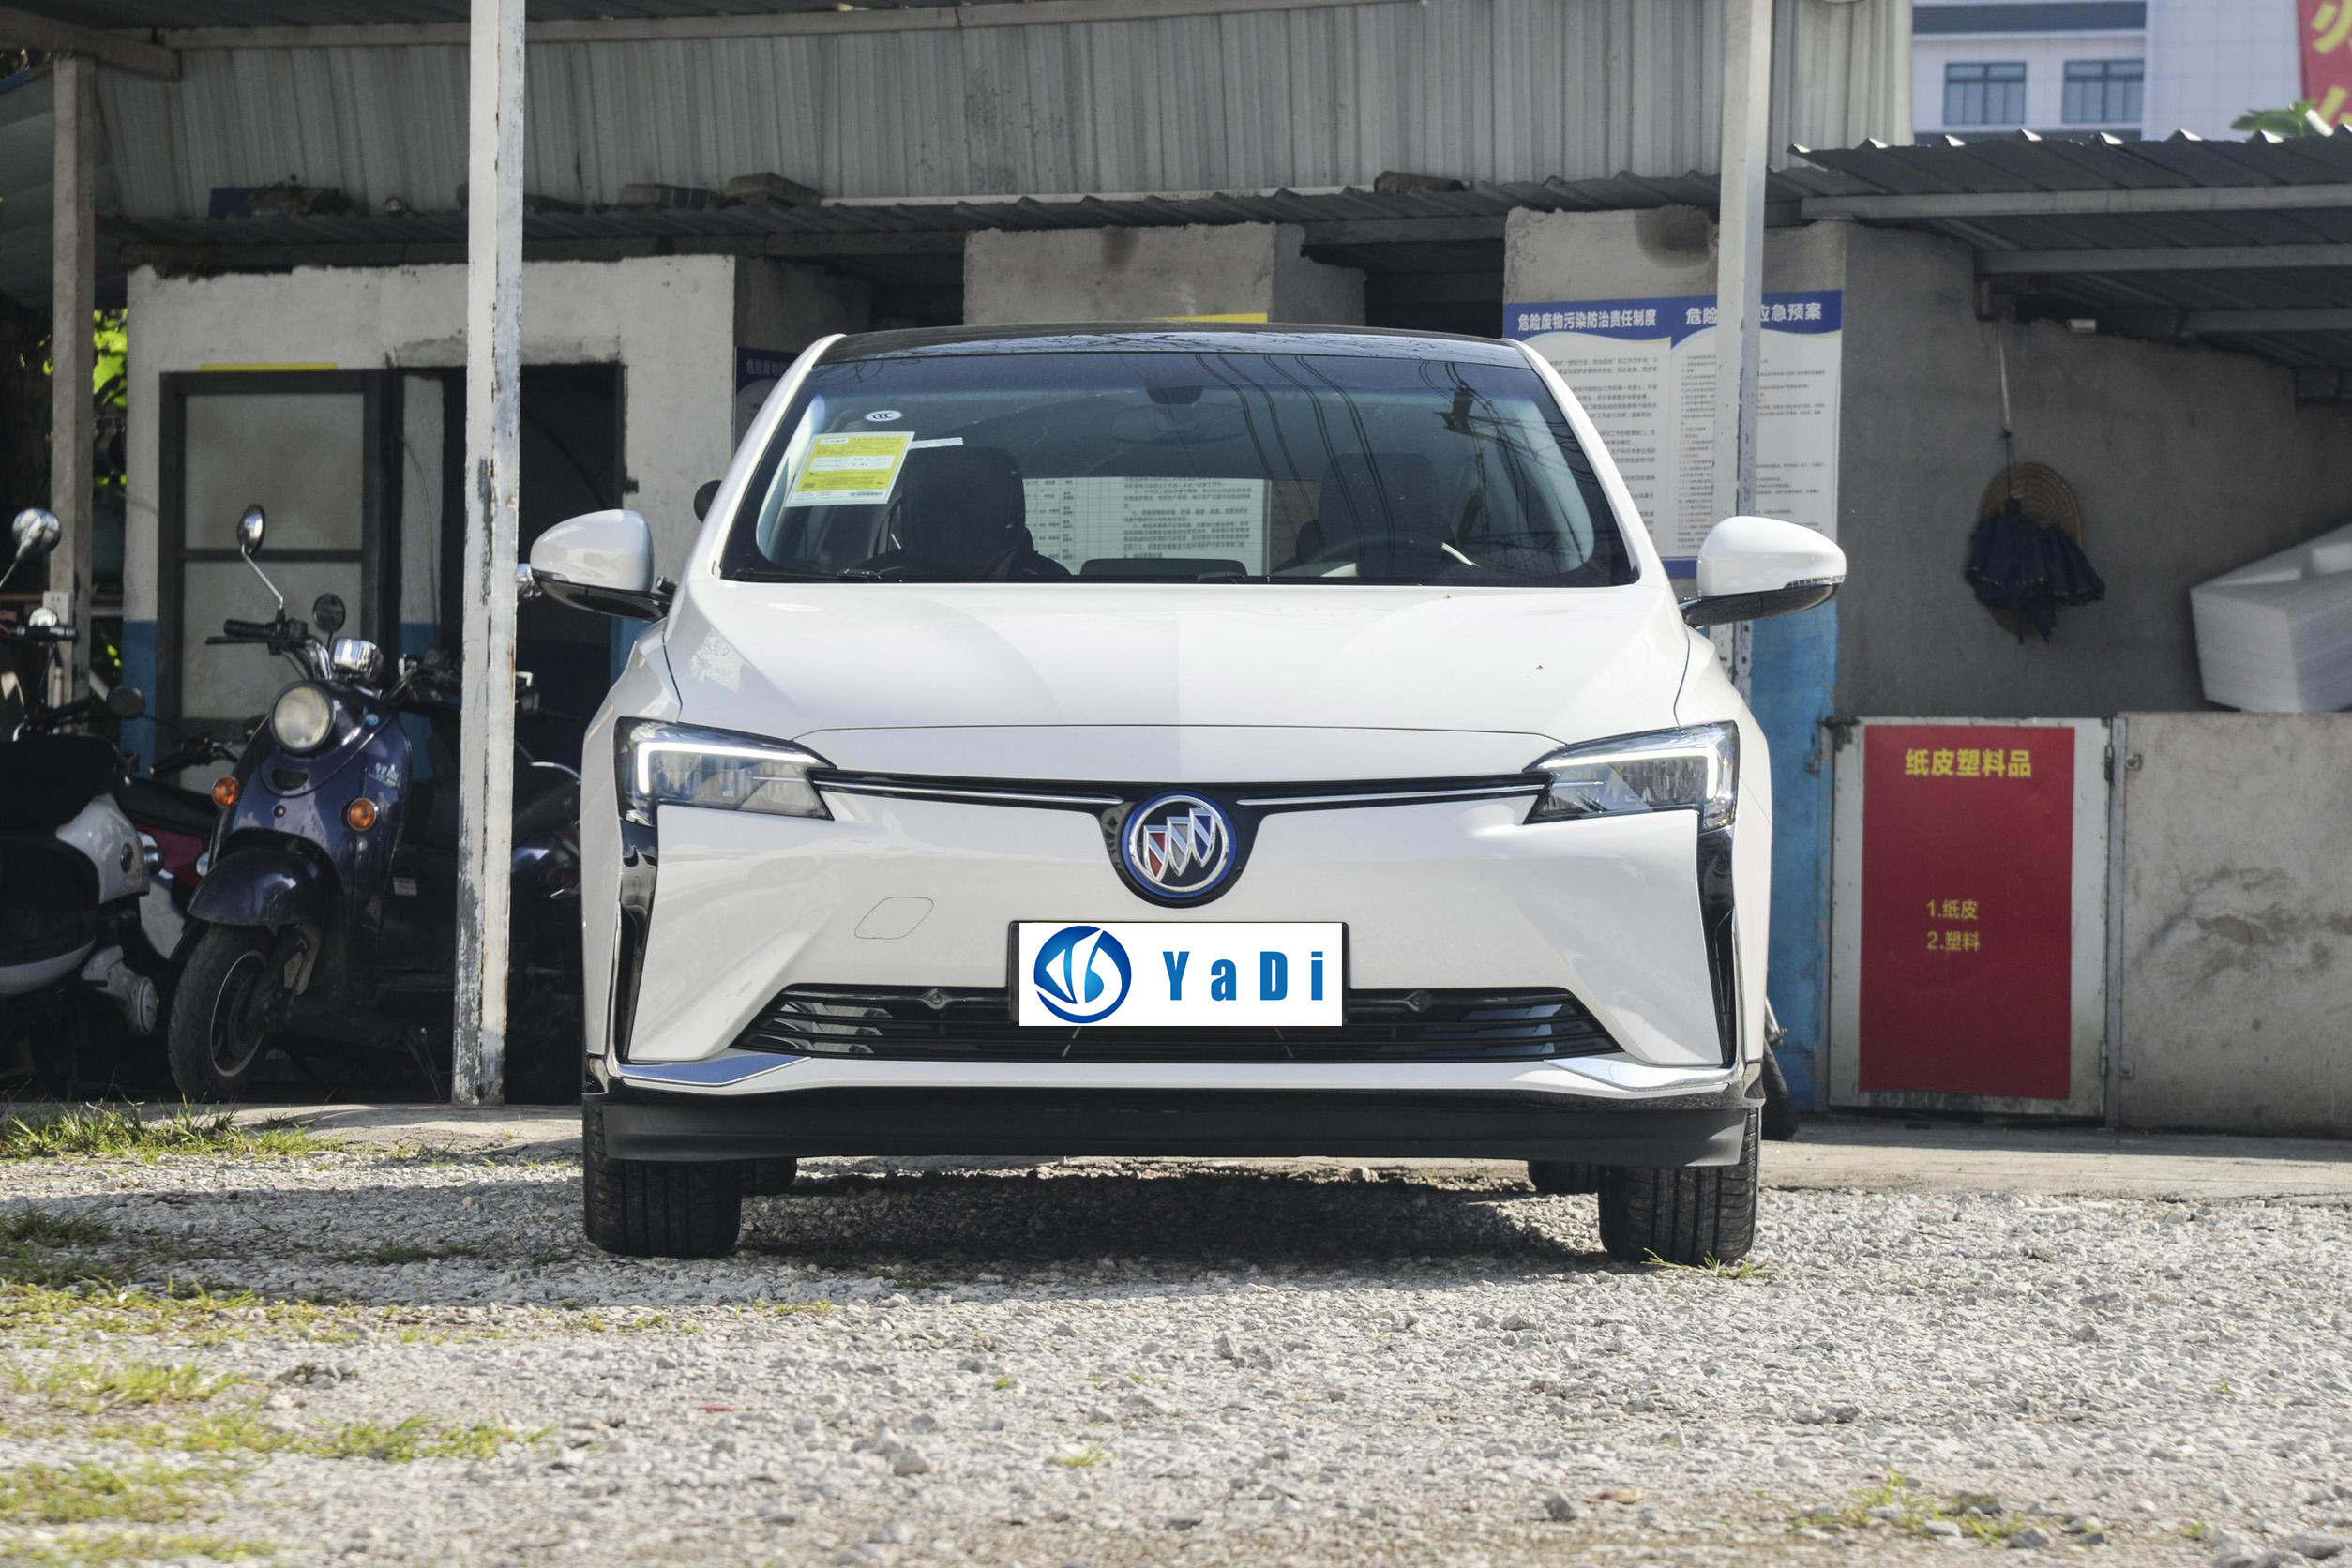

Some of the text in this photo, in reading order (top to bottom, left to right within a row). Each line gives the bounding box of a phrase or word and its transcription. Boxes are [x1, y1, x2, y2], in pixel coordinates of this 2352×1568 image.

[1517, 309, 1657, 331] 危险废物污染防治责任制度
[1685, 302, 1822, 325] 危险应急预案
[1905, 748, 2032, 777] 纸皮塑料品
[1926, 898, 1979, 920] 1.纸皮
[1926, 930, 1981, 952] 2.塑料
